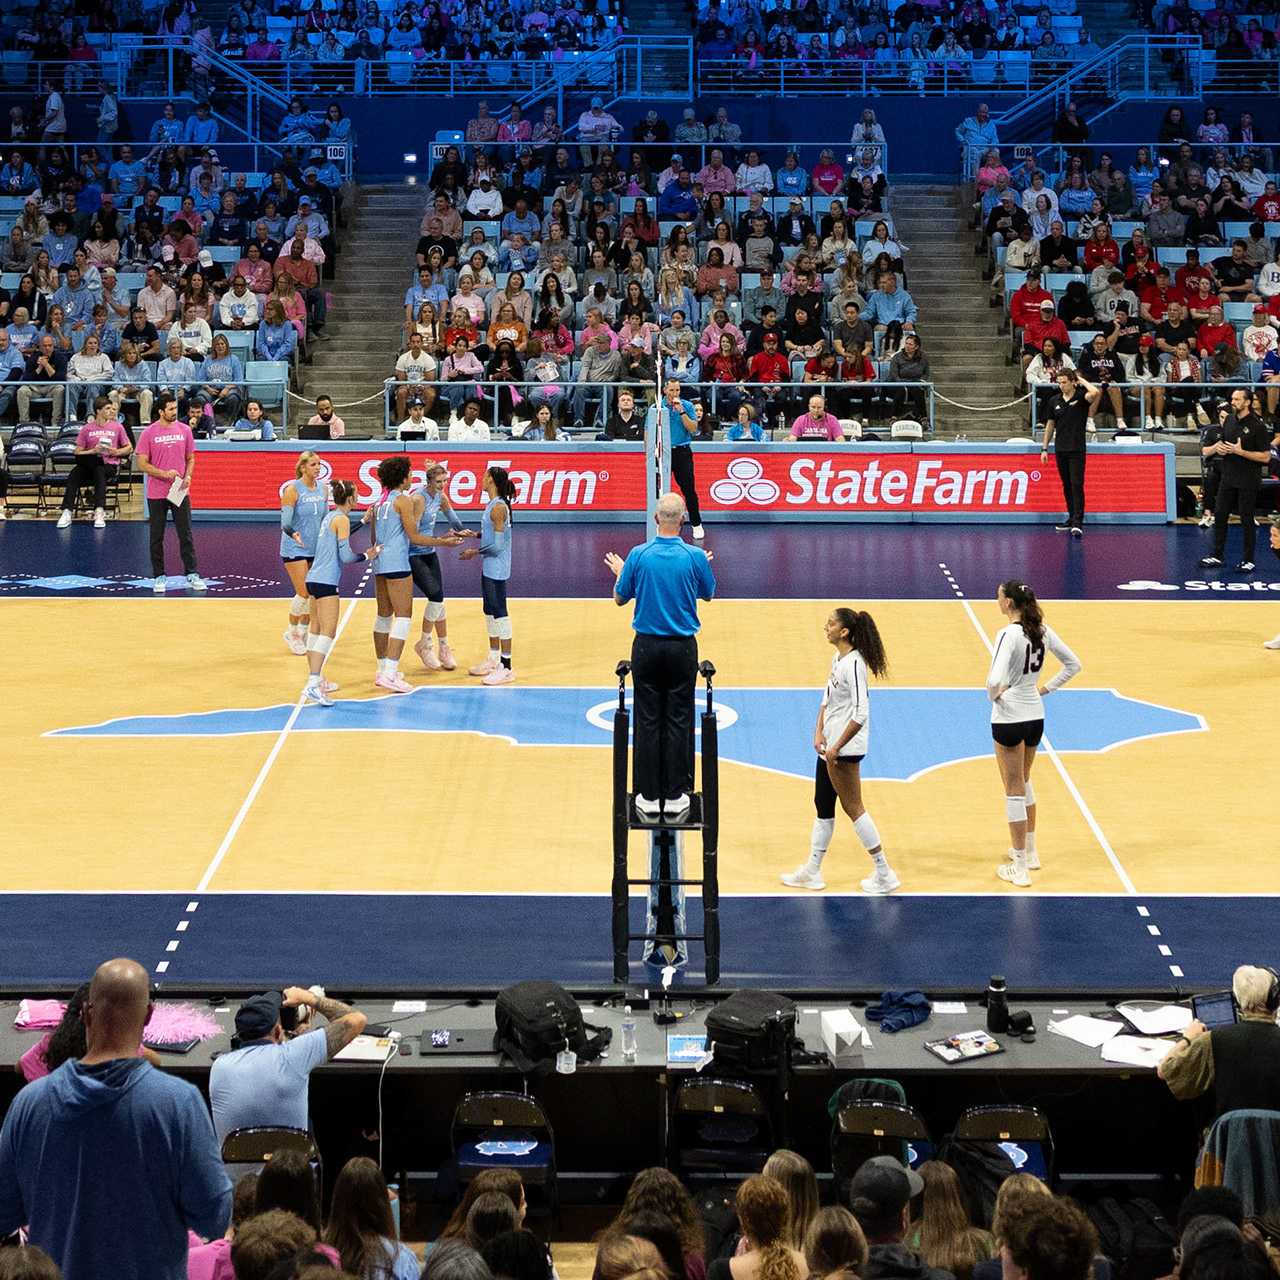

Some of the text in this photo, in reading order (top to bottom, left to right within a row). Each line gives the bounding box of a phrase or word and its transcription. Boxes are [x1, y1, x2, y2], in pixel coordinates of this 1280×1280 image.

[328, 147, 344, 158] 106
[1015, 147, 1031, 158] 108
[155, 435, 184, 443] CAROLINA
[785, 458, 1029, 506] State Farm
[313, 503, 318, 515] 1
[1022, 643, 1045, 675] 13
